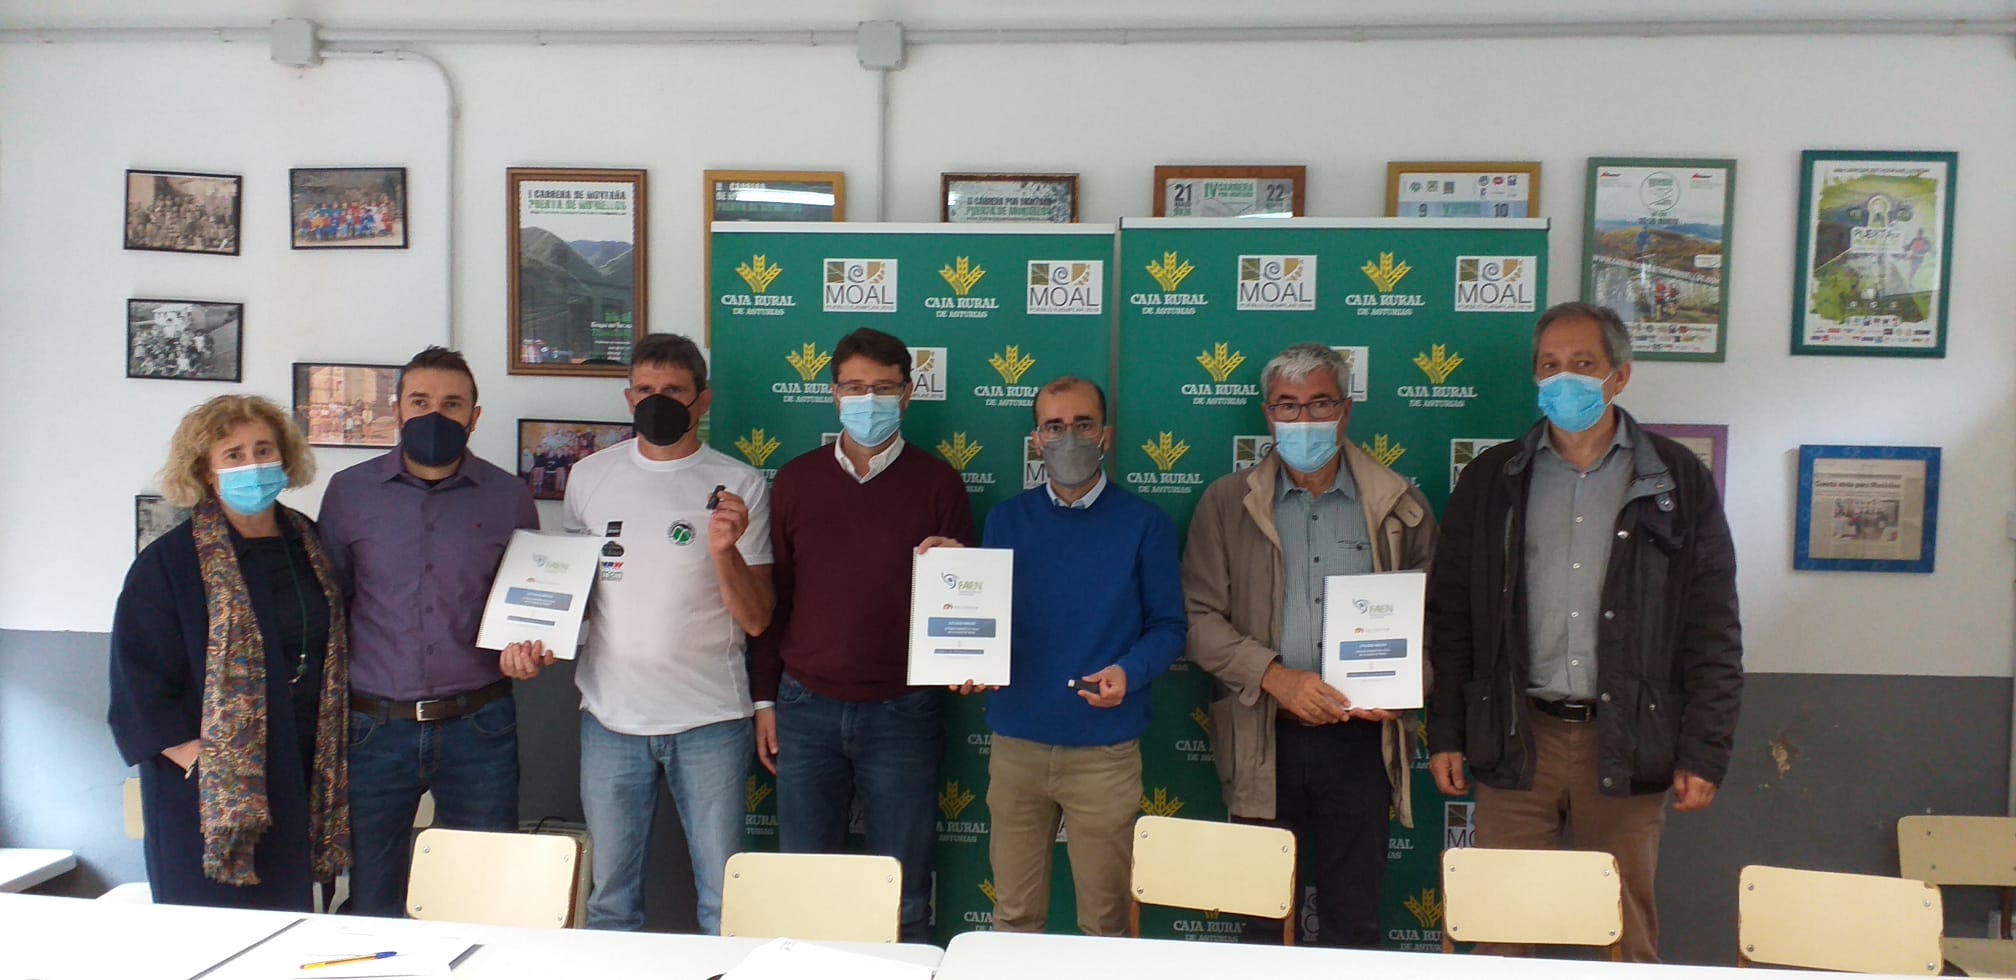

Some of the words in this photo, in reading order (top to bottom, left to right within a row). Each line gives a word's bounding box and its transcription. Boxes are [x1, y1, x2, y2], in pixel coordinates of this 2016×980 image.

[534, 190, 571, 199] CARRERA
[574, 190, 585, 199] DE
[1174, 183, 1193, 202] 21
[1204, 182, 1218, 200] IV
[1266, 183, 1285, 202] 22
[1494, 203, 1510, 218] 10
[826, 284, 895, 304] MOAL
[1030, 286, 1100, 307] MOAL
[1240, 282, 1313, 303] MOAL
[1458, 283, 1532, 304] MOAL
[721, 294, 751, 306] CAJA
[754, 295, 796, 306] RURAL
[925, 297, 955, 309] CAJA
[957, 297, 999, 309] RURAL
[1130, 294, 1162, 305] CAJA
[1164, 294, 1208, 305] RURAL
[1345, 295, 1378, 306] CAJA
[1380, 295, 1426, 307] RURAL
[936, 310, 947, 318] DE
[1357, 308, 1369, 316] DE
[772, 383, 802, 394] CAJA
[914, 373, 944, 393] AL
[974, 386, 1005, 397] CAJA
[1007, 386, 1038, 398] RURA
[1181, 384, 1213, 396] CAJA
[1214, 384, 1259, 396] RURAL
[1397, 386, 1430, 398] CAJA
[1432, 386, 1478, 398] RURAL
[986, 398, 997, 406] DE
[1192, 397, 1204, 405] DE
[1409, 399, 1421, 407] DE
[961, 473, 996, 484] URAL
[1127, 472, 1157, 484] CAJA
[1160, 473, 1204, 484] RURAL
[958, 580, 983, 591] FAEN
[1175, 740, 1207, 752] CAJA
[745, 814, 778, 826] RURA
[946, 822, 989, 834] RURAL
[1388, 838, 1414, 850] RAL
[963, 911, 993, 923] CAJA
[1173, 920, 1204, 932] CAJA
[1206, 921, 1247, 933] RURA
[1389, 929, 1421, 941] CAJA
